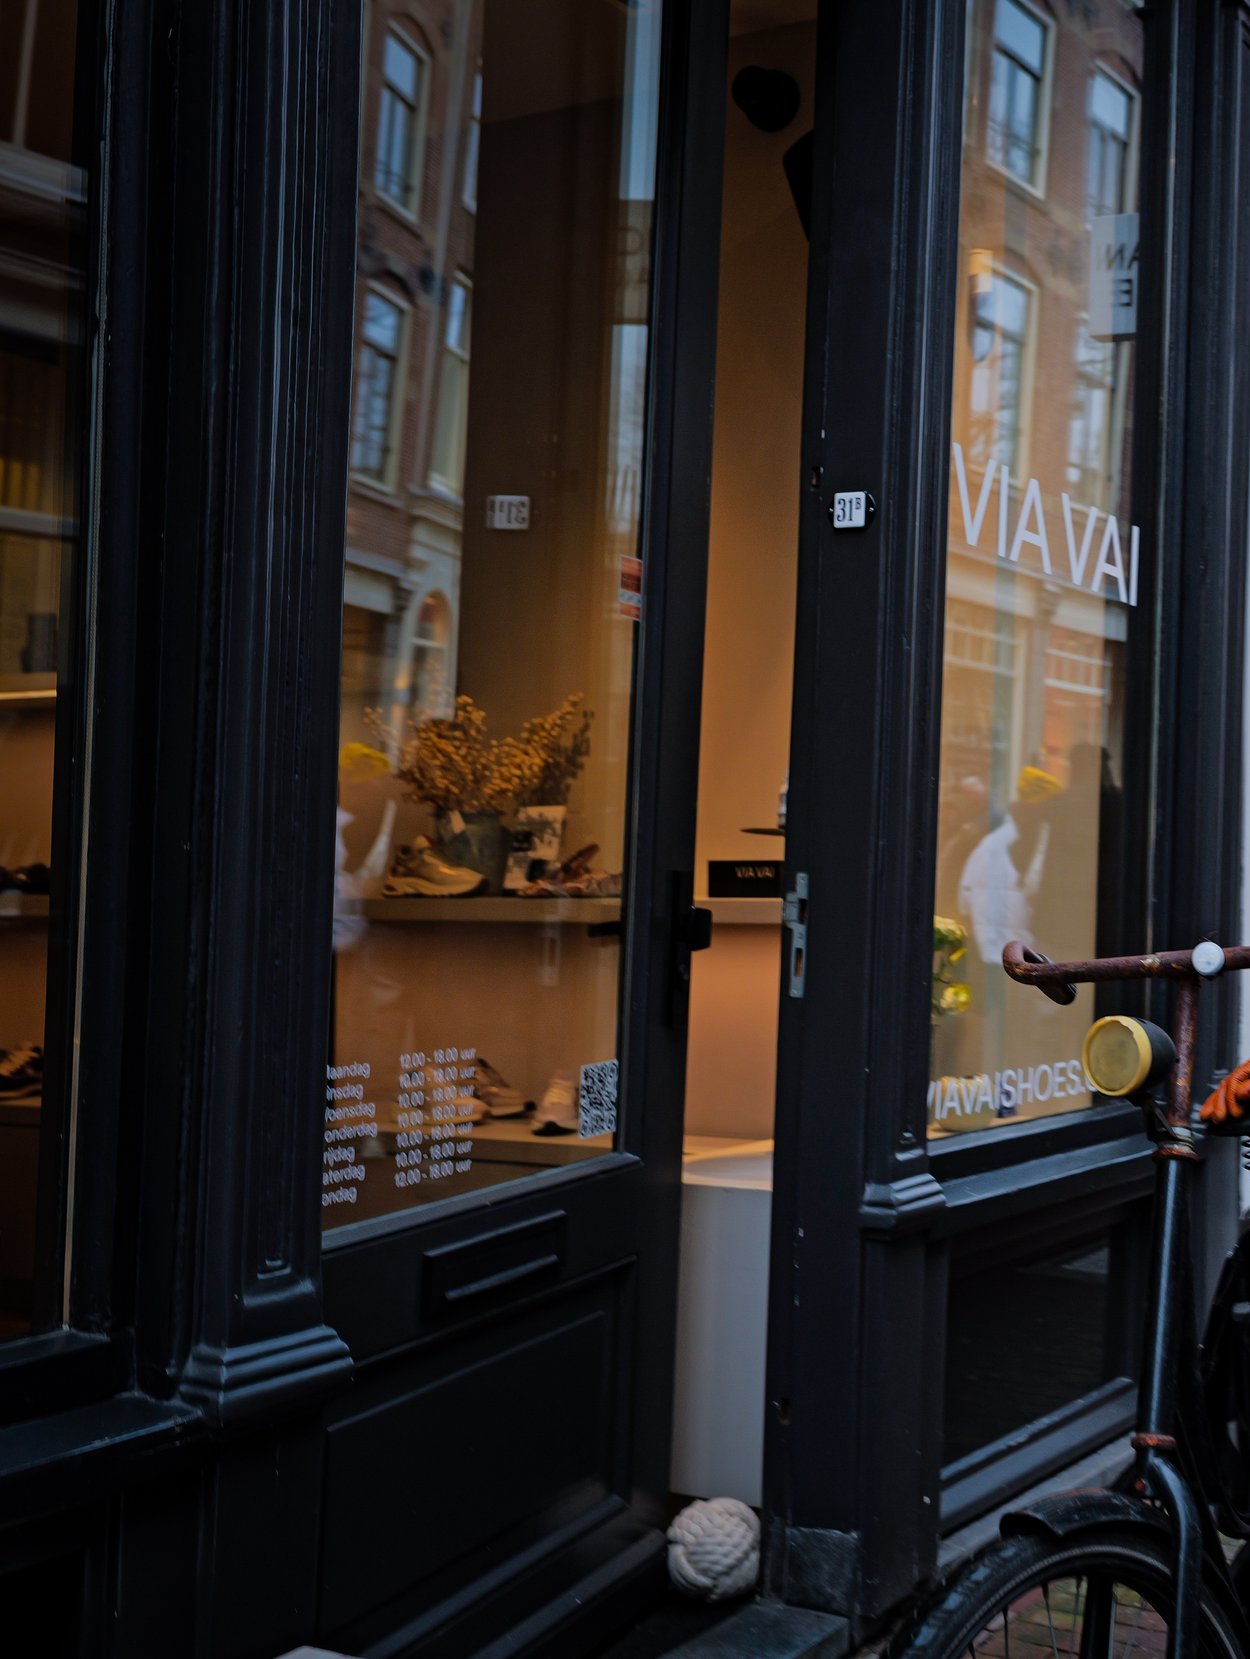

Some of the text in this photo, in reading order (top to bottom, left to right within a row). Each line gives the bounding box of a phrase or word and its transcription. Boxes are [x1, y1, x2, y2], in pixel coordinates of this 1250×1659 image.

[952, 441, 1140, 607] VIA VAI
[326, 1061, 371, 1080] aandag
[326, 1082, 364, 1101] insdag
[926, 1059, 1099, 1121] IAVAISHOES.
[325, 1102, 376, 1123] oensdag
[324, 1121, 378, 1143] onderdag
[323, 1146, 356, 1167] rijdag
[322, 1164, 366, 1186] aterdag
[321, 1186, 357, 1206] ondag
